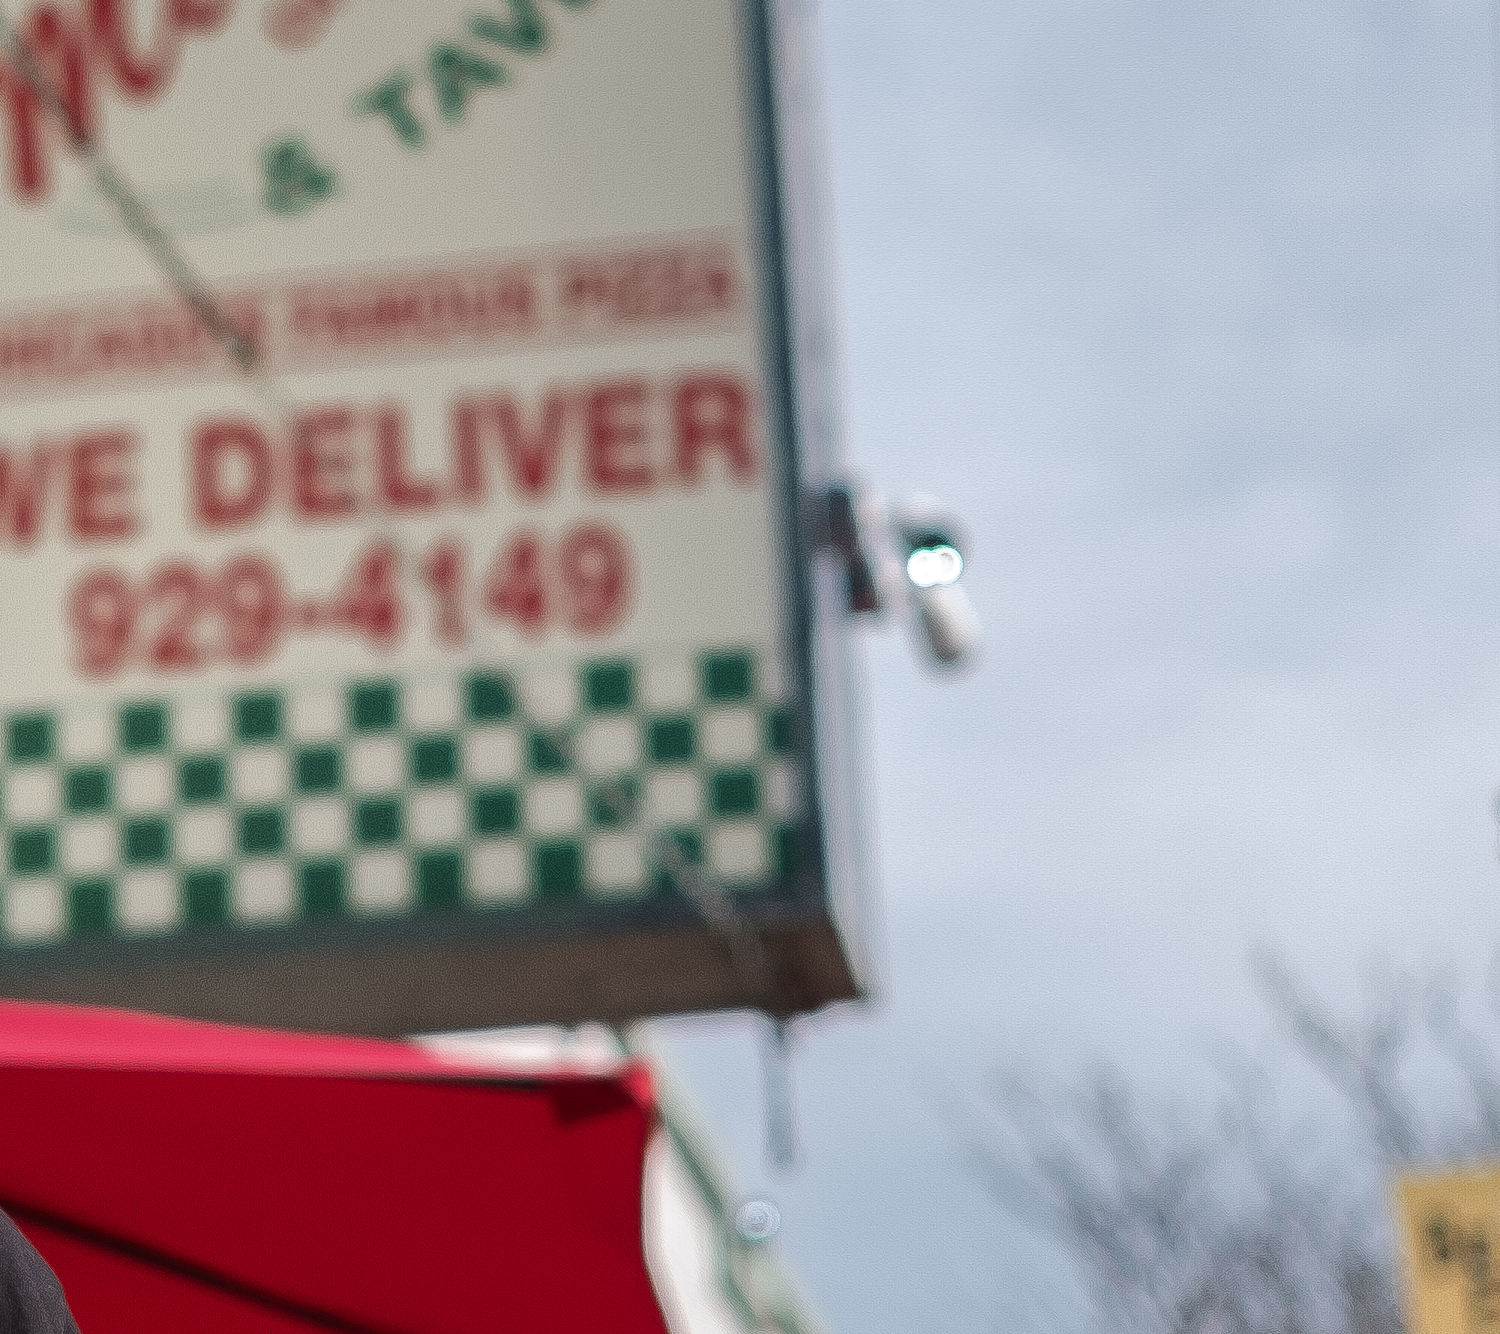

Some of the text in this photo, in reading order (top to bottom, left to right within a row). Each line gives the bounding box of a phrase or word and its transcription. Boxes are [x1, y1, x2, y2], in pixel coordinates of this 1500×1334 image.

[262, 136, 337, 214] &
[191, 372, 755, 531] DELIVER
[66, 522, 632, 679] 929-4149
